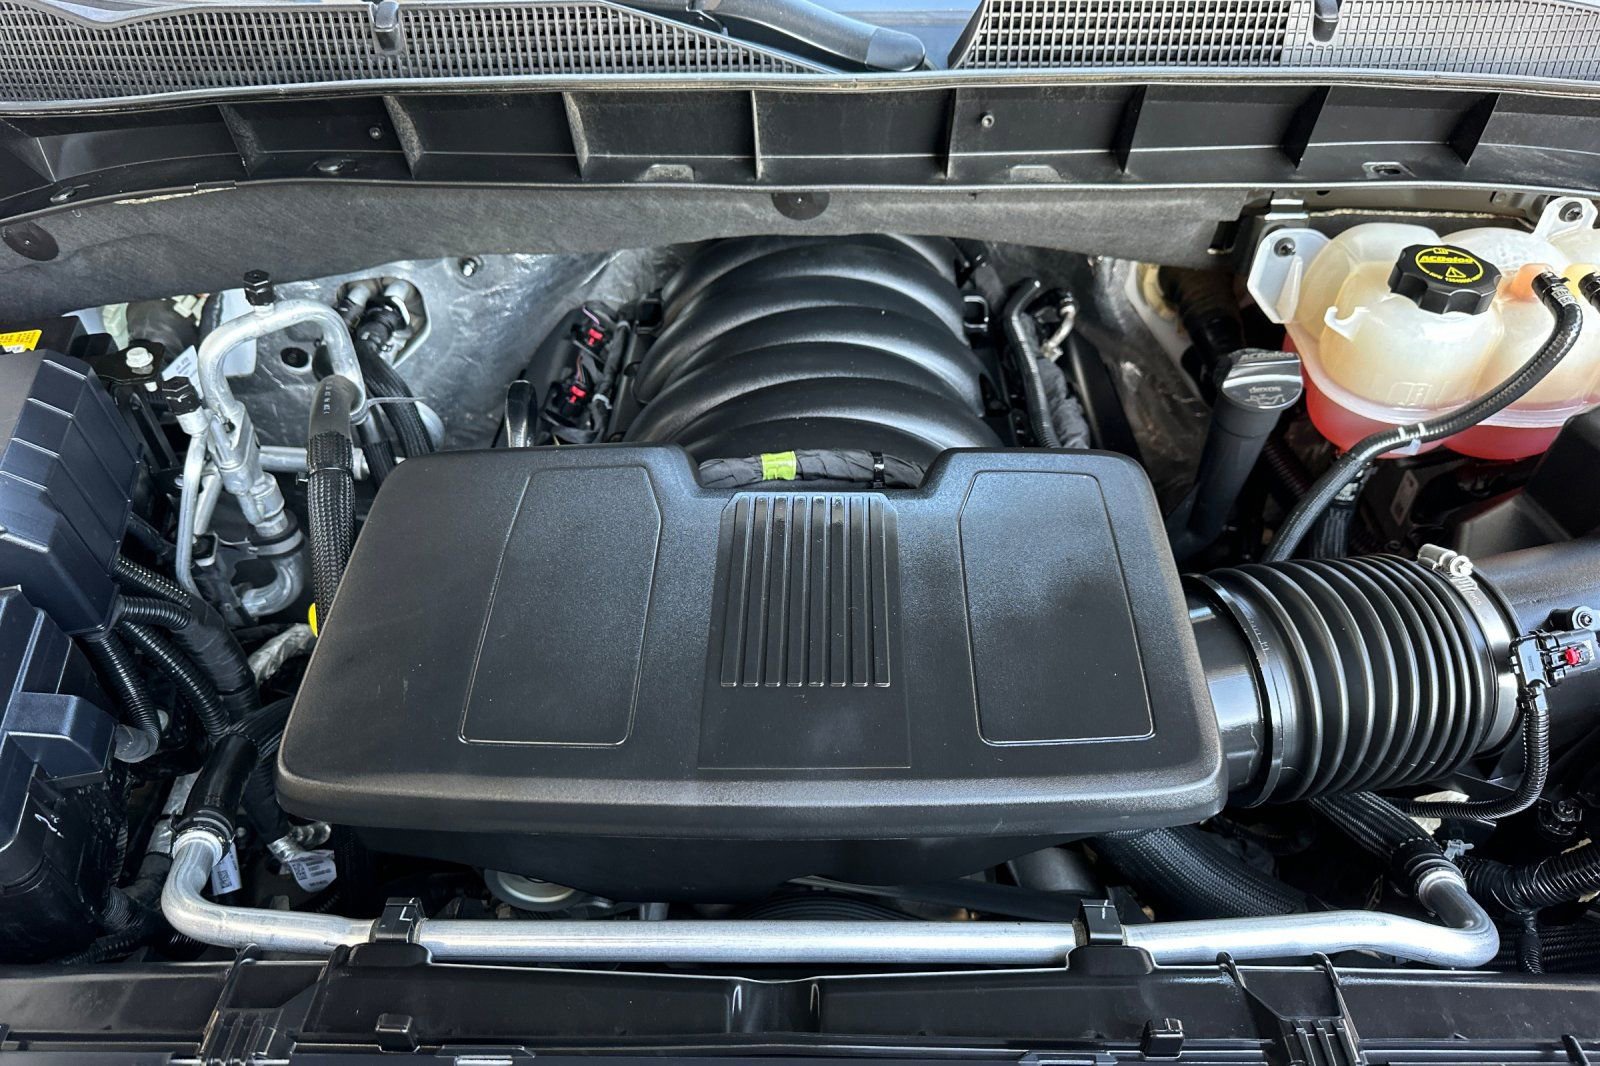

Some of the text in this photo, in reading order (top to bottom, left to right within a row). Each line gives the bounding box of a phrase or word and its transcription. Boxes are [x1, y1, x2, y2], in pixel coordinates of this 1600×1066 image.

[1419, 255, 1475, 264] ACDelco
[1239, 351, 1295, 362] ACDelco
[1248, 386, 1281, 394] dexos
